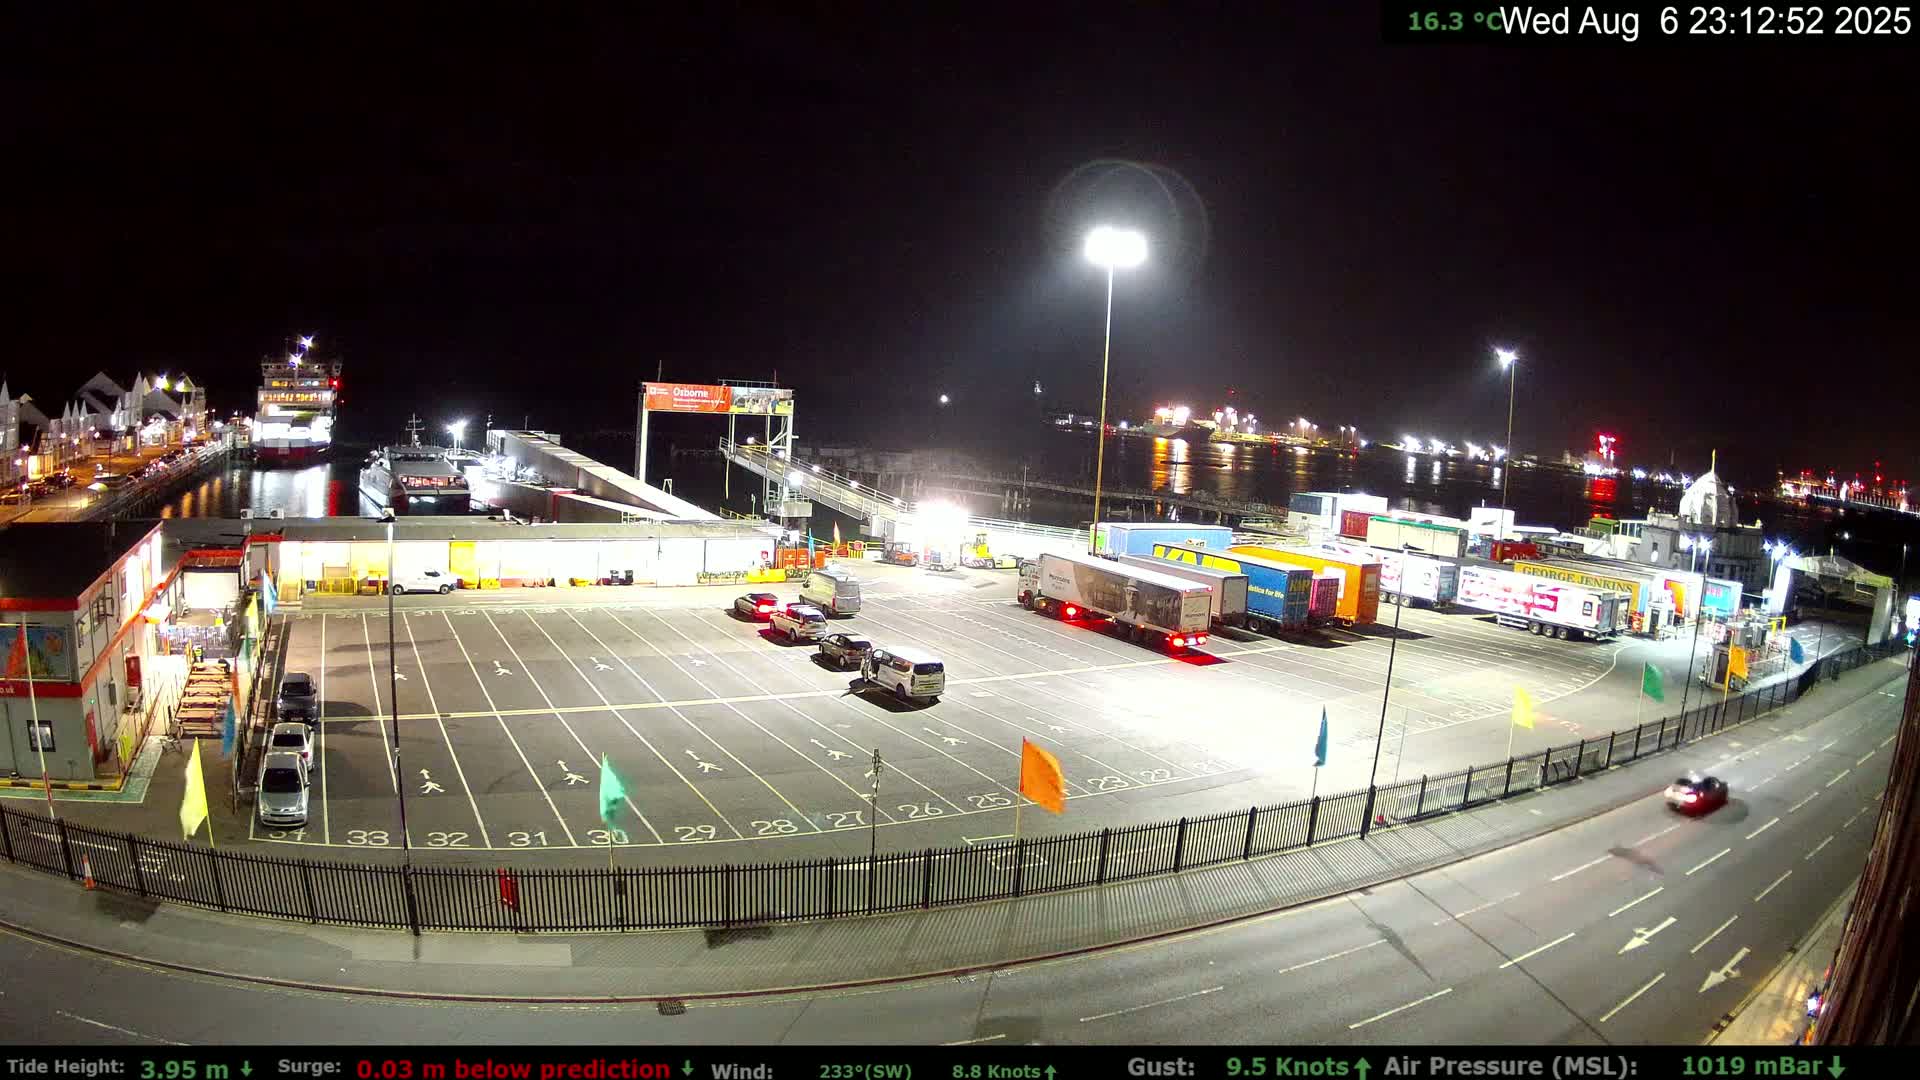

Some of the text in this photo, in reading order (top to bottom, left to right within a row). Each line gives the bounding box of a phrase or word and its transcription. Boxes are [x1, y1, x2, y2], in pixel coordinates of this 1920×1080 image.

[673, 386, 709, 398] Osborne
[1523, 565, 1633, 592] GEORGE JENKINS
[1088, 775, 1129, 791] 23
[967, 793, 1012, 809] 25
[826, 810, 866, 828] 27
[900, 803, 943, 819] 26
[674, 824, 716, 842] 29
[751, 819, 798, 836] 28
[347, 829, 390, 846] 33
[427, 831, 469, 848] 32
[508, 831, 549, 847] 31
[587, 828, 630, 845] 30
